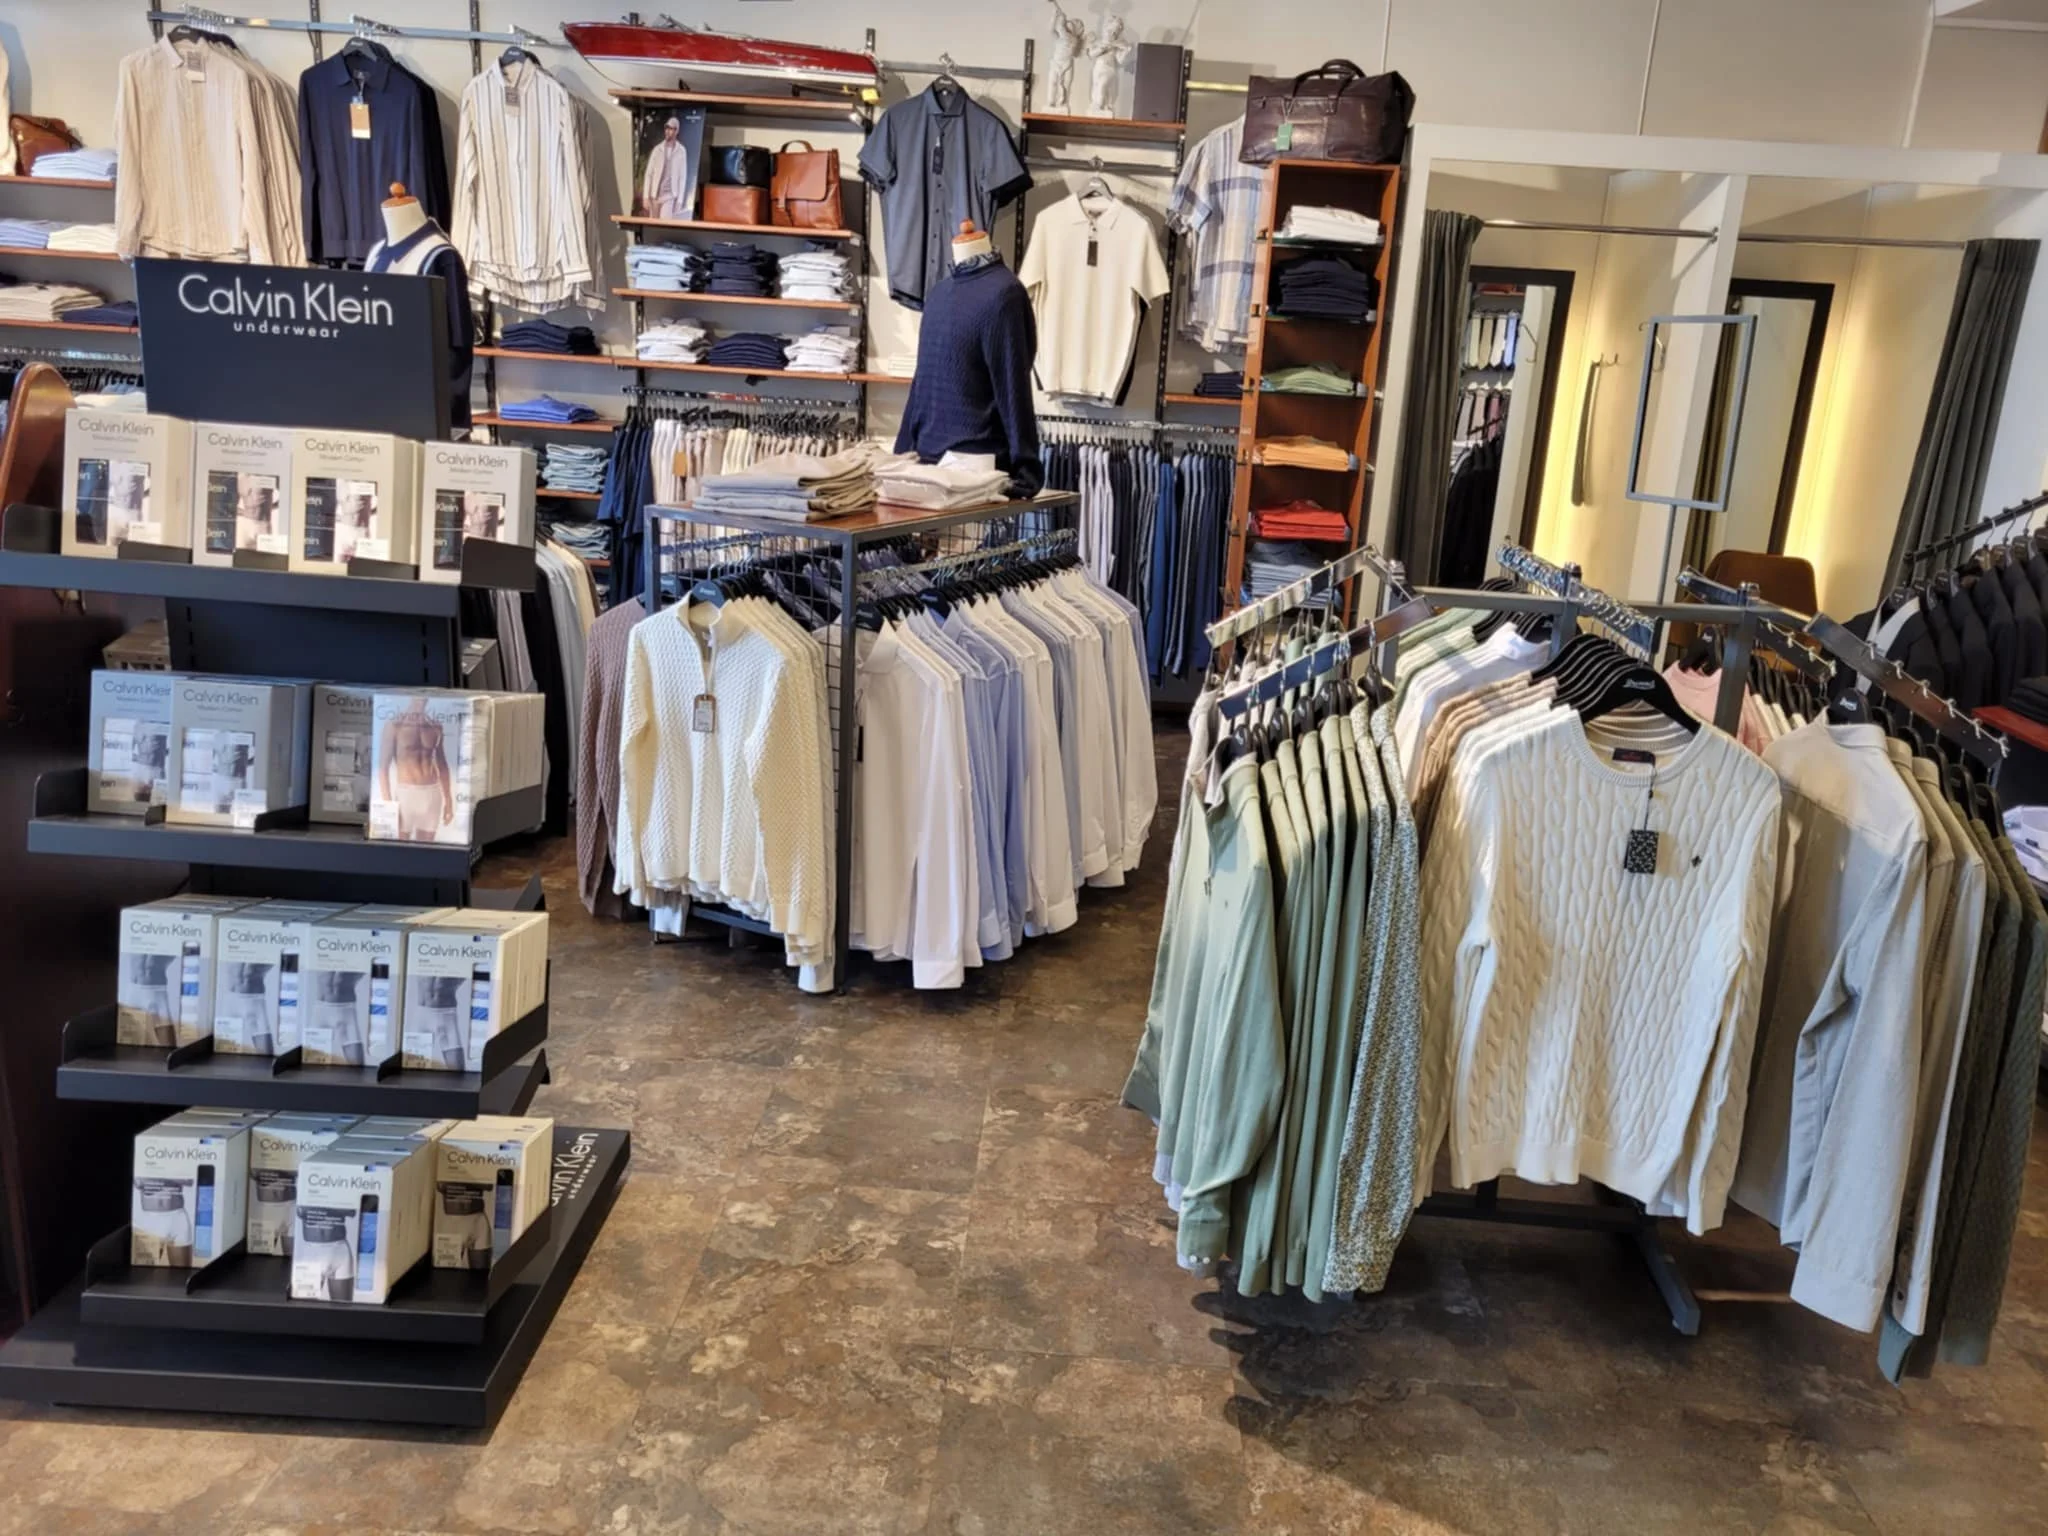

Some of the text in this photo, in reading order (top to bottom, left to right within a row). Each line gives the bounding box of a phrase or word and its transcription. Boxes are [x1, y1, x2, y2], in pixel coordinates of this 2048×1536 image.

[178, 274, 393, 326] Calvin Klein
[233, 321, 340, 338] underwear
[78, 418, 154, 436] Calvin Klein
[208, 432, 282, 449] Calvin Klein
[305, 438, 380, 455] Calvin Klein
[436, 452, 509, 469] Calvin Klein
[102, 680, 143, 695] Calvin
[183, 689, 259, 706] Calvin Klein
[326, 694, 367, 706] Calvin
[375, 705, 420, 721] Calvin
[130, 921, 202, 937] Calvin Klein
[227, 929, 300, 946] Calvin Klein
[316, 938, 391, 954] Calvin Klein
[418, 943, 492, 959] Calvin Klein
[144, 1146, 217, 1161] Calvin Klein
[260, 1138, 298, 1152] Calvin
[553, 1132, 599, 1169] Klein
[447, 1151, 516, 1166] Calvin Klein
[308, 1173, 349, 1188] Calvin
[350, 1176, 382, 1190] Klein
